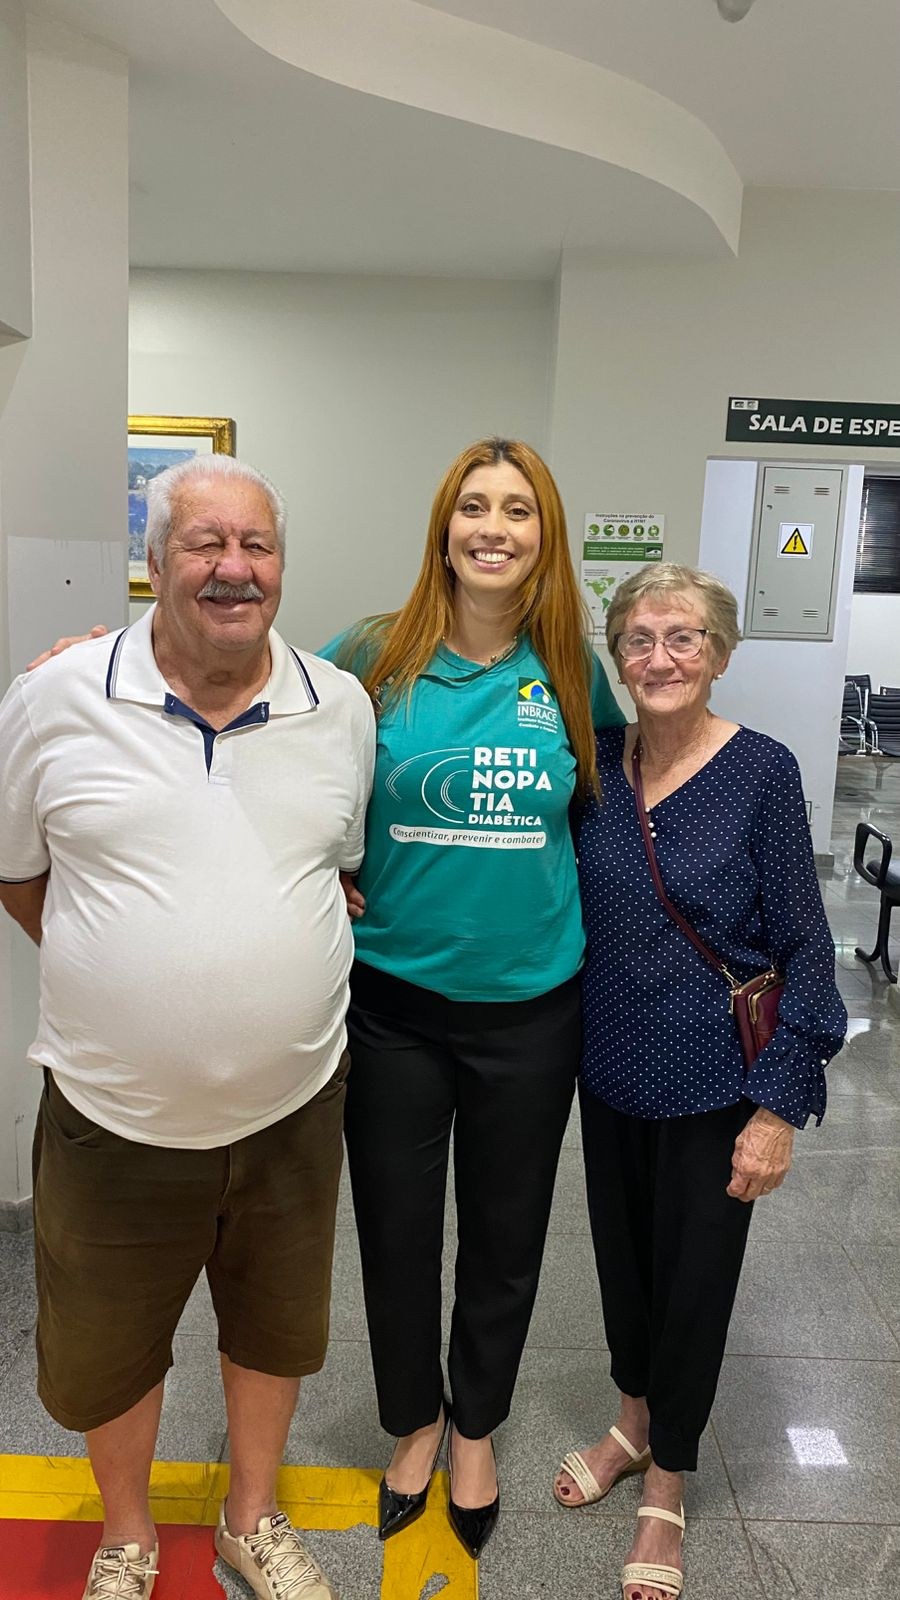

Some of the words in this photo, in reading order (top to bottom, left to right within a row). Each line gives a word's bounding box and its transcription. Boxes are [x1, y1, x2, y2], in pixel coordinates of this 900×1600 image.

[749, 414, 808, 433] SALA
[813, 417, 844, 434] DE
[474, 746, 537, 767] RETI
[472, 769, 553, 791] NOPA
[470, 792, 514, 812] TIA
[468, 813, 542, 826] DIABÉTICA
[393, 827, 450, 842] Conscientizar,
[452, 833, 493, 844] prevenir
